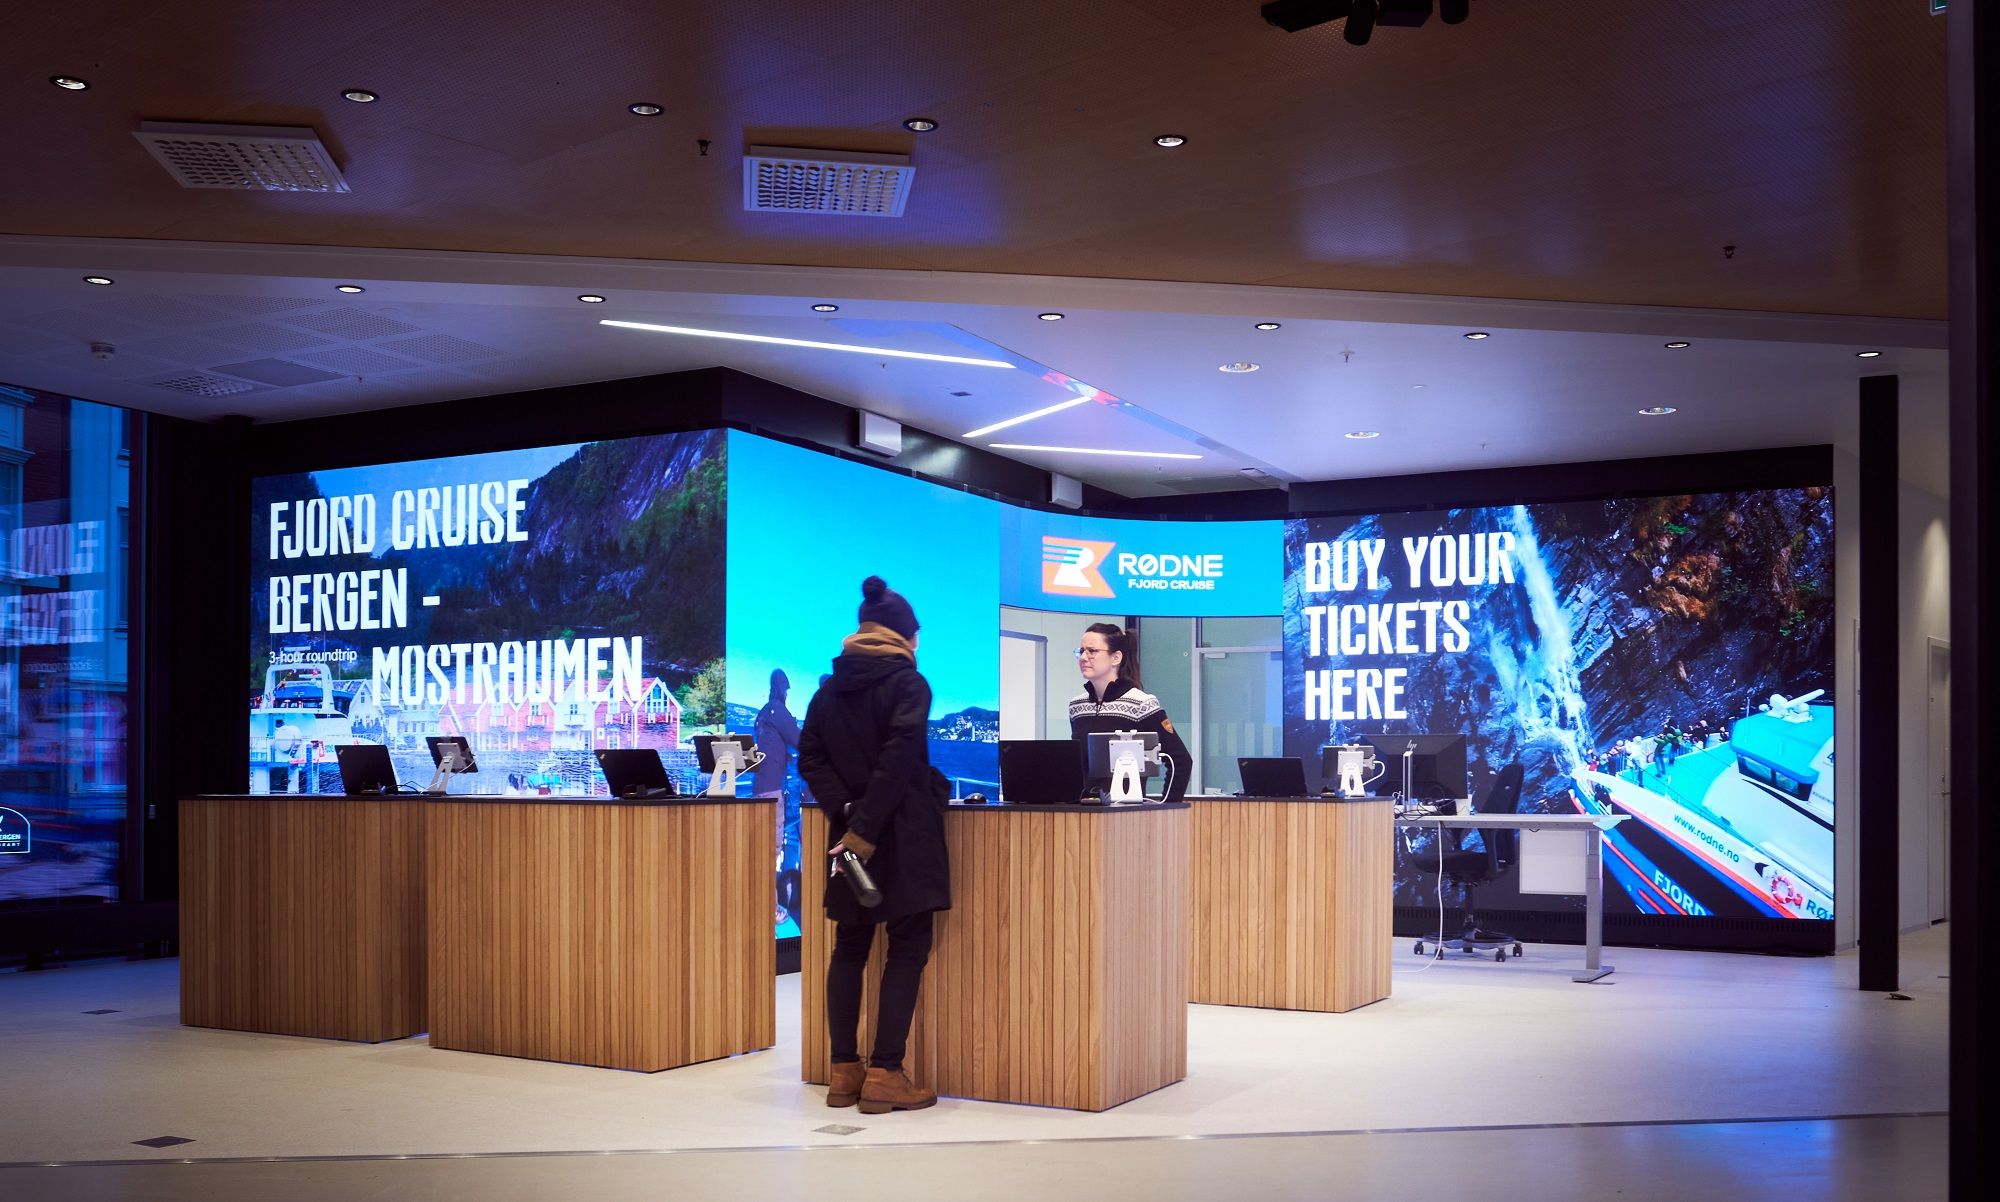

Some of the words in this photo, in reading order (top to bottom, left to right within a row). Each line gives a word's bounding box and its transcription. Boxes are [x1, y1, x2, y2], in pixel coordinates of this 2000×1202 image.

[270, 493, 376, 559] FJORD
[392, 478, 529, 551] CRUISE
[1118, 552, 1224, 577] RØDNE
[1128, 578, 1169, 589] FJORD
[1170, 579, 1215, 590] CRUISE
[1305, 538, 1385, 592] BUY
[1402, 531, 1515, 588] YOUR
[269, 567, 407, 633] BERGEN
[1304, 600, 1470, 656] TICKETS
[269, 650, 304, 664] 3-hour
[306, 648, 357, 663] roundtrip
[372, 636, 642, 706] MOSTRAUMEN
[1305, 667, 1408, 720] HERE
[1674, 813, 1740, 863] www.rodne.no
